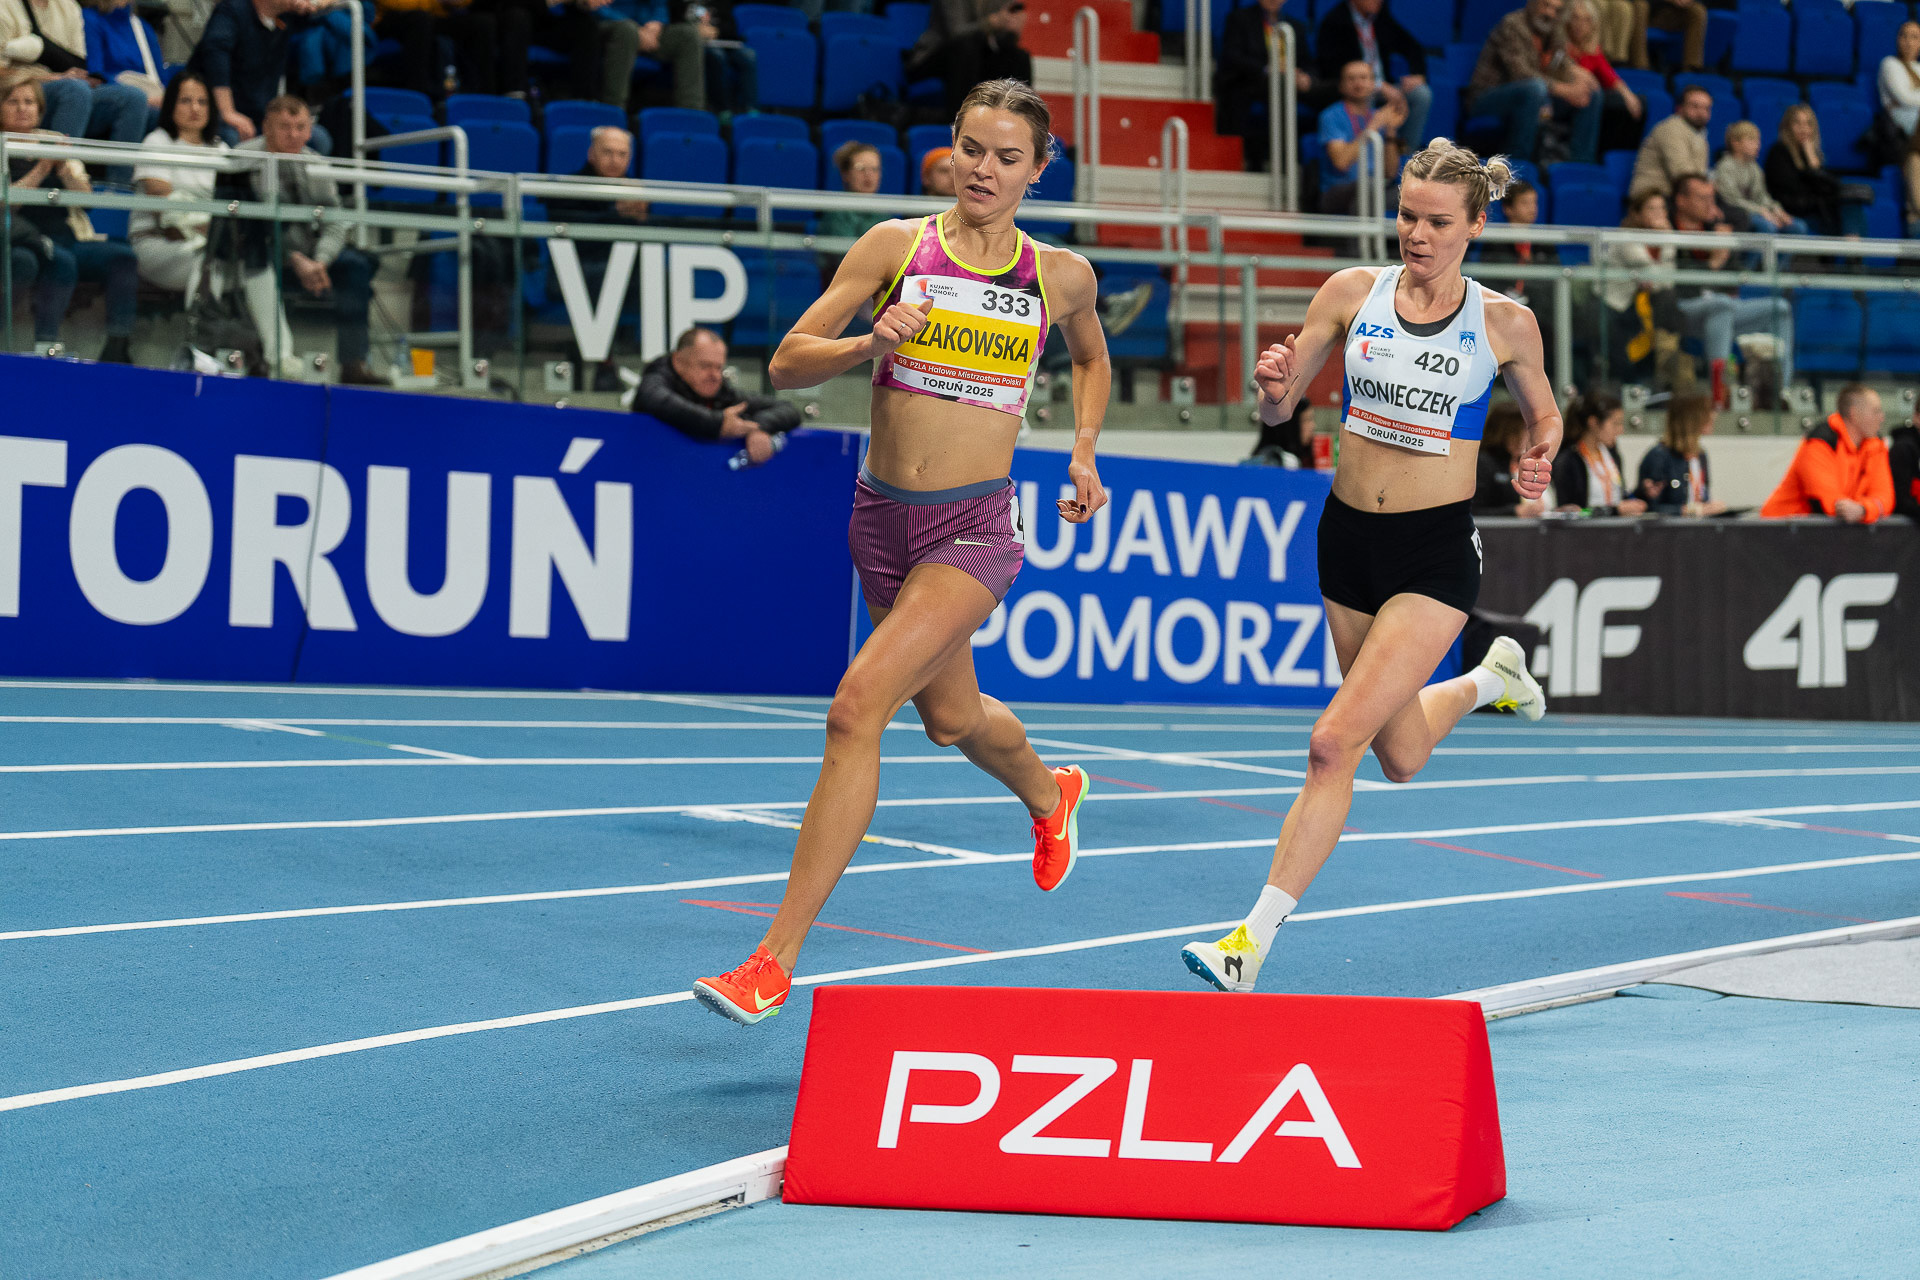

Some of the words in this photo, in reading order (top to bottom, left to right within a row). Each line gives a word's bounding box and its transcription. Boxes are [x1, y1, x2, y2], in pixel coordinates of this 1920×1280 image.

[547, 238, 748, 362] VIP
[929, 284, 954, 292] KUJAWY
[929, 289, 959, 298] POMORZE
[981, 289, 1031, 317] 333
[906, 320, 1029, 363] ZAKOWSKA
[1355, 322, 1395, 339] AZS
[898, 357, 909, 367] 69.
[910, 362, 927, 371] PZLA
[928, 366, 957, 377] Halowe
[958, 371, 1001, 384] Mistrzostwa
[1002, 377, 1022, 386] Polski
[1414, 351, 1460, 377] 420
[922, 377, 964, 393] TORUŃ
[965, 384, 994, 398] 2025
[1351, 375, 1458, 417] KONIECZEK
[1352, 408, 1360, 416] 69.
[1360, 411, 1373, 421] PZLA
[1373, 415, 1392, 427] Halowe
[1392, 420, 1431, 436] Mistrzostwa
[1431, 429, 1448, 438] Polski
[1367, 425, 1398, 441] TORUŃ
[1399, 434, 1424, 447] 2025
[1014, 480, 1307, 583] UJAWY
[1742, 572, 1900, 689] 4F
[877, 1049, 1363, 1169] PZLA
